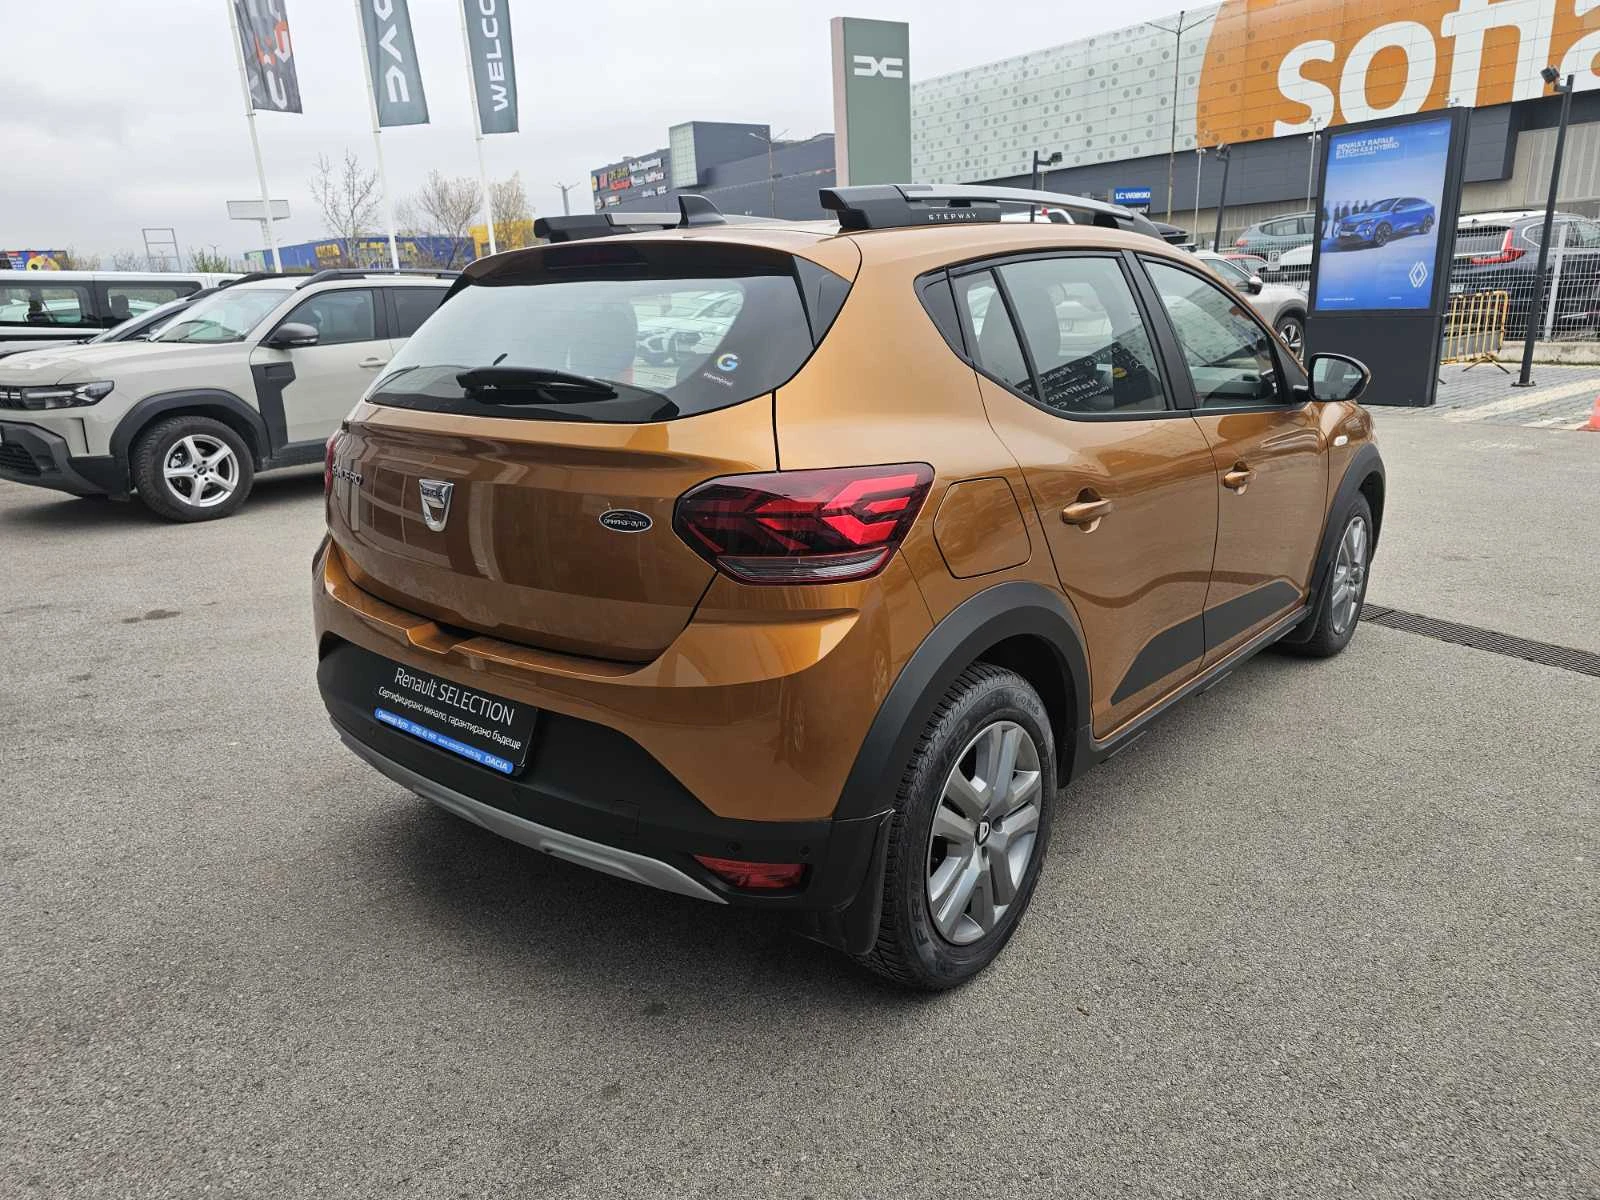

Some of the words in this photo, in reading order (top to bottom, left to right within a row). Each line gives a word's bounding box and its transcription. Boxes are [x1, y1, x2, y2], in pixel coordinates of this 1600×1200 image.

[928, 212, 977, 221] STEPWAY
[394, 667, 438, 698] Renault
[437, 683, 515, 726] SELECTION
[378, 686, 424, 712] Сертифицирано
[423, 704, 448, 723] минало,
[447, 715, 492, 738] гарантирано
[491, 729, 522, 750] бъдеще
[484, 755, 508, 770] DACIA
